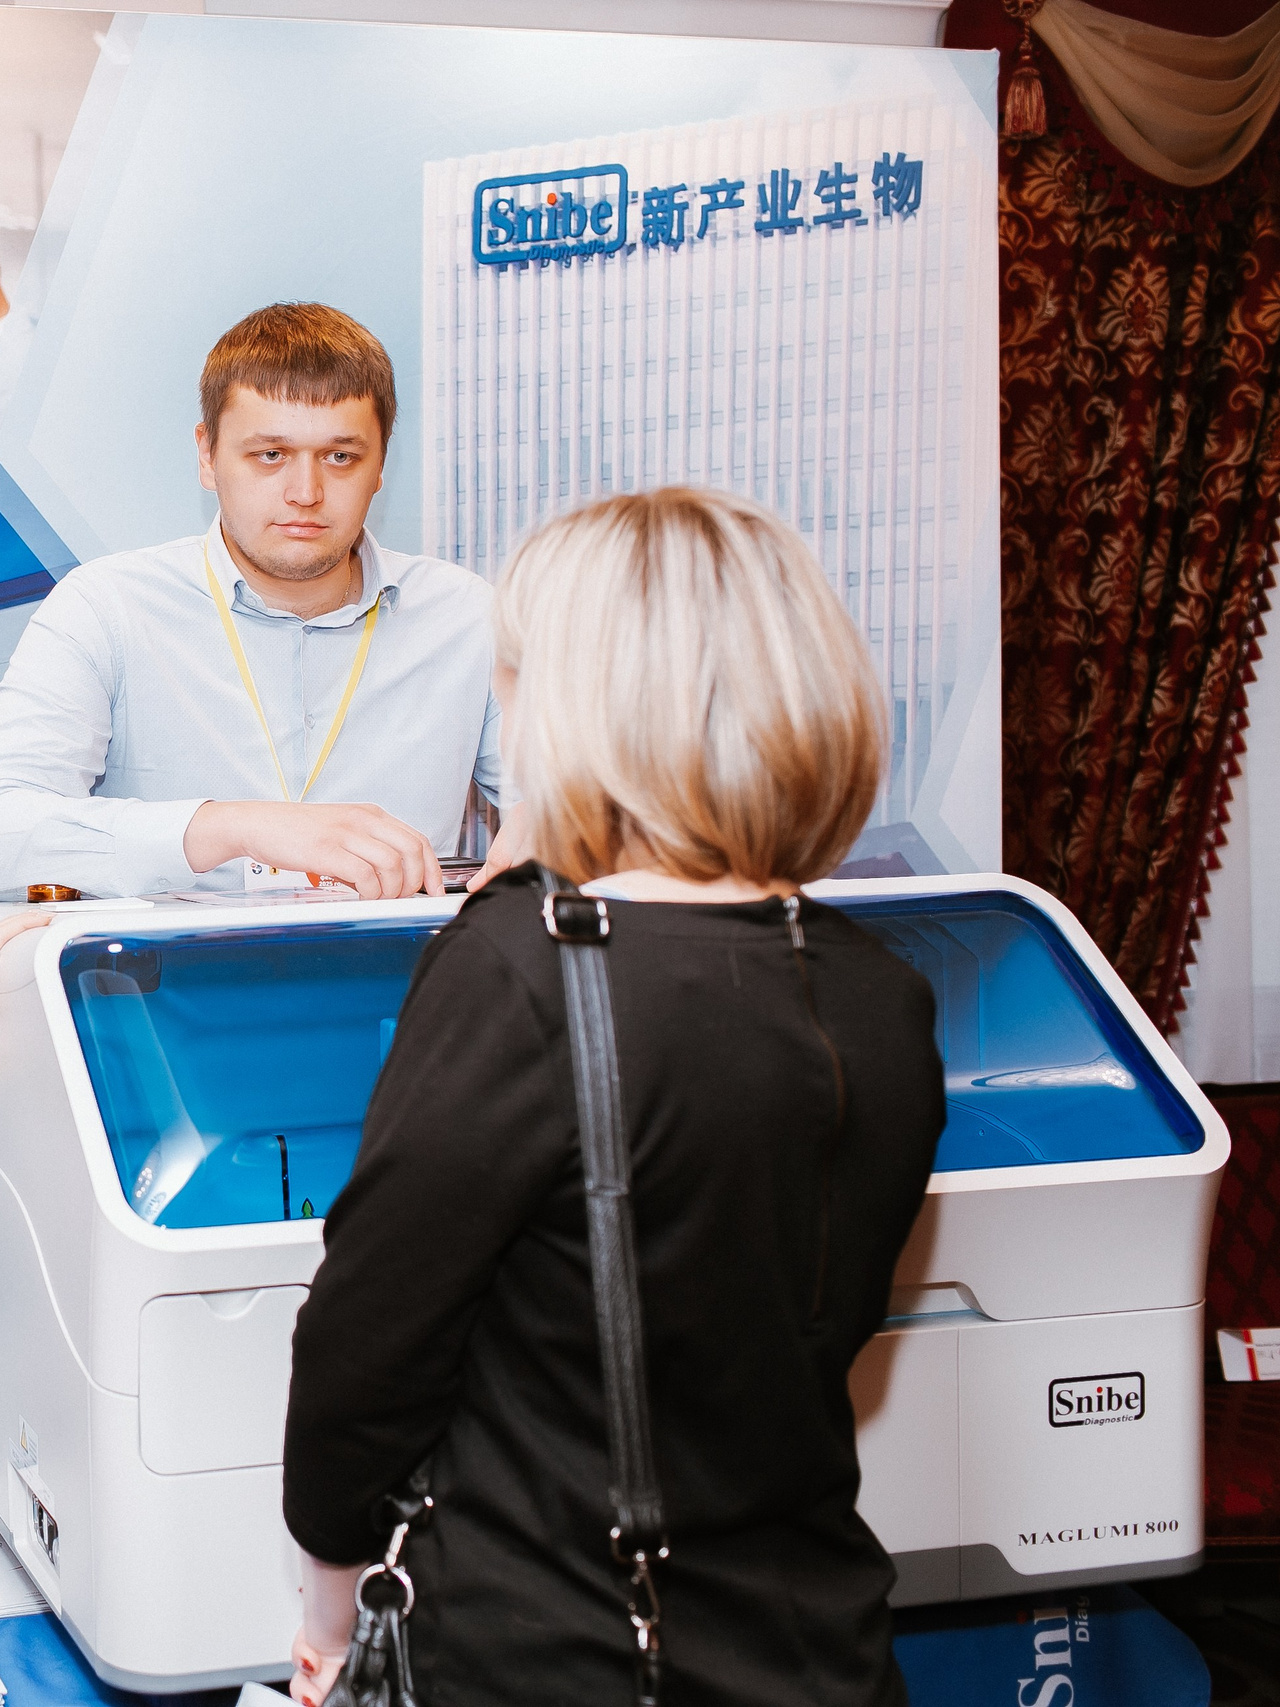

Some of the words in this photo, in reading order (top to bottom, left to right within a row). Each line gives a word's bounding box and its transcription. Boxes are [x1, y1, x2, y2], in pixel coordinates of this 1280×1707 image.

[640, 151, 924, 245] 新产业生物
[488, 192, 613, 247] Snibe
[1055, 1386, 1140, 1416] Snibe
[1084, 1414, 1134, 1427] Diagnostic
[1018, 1522, 1139, 1547] MAGLUMI
[1145, 1519, 1179, 1535] 800
